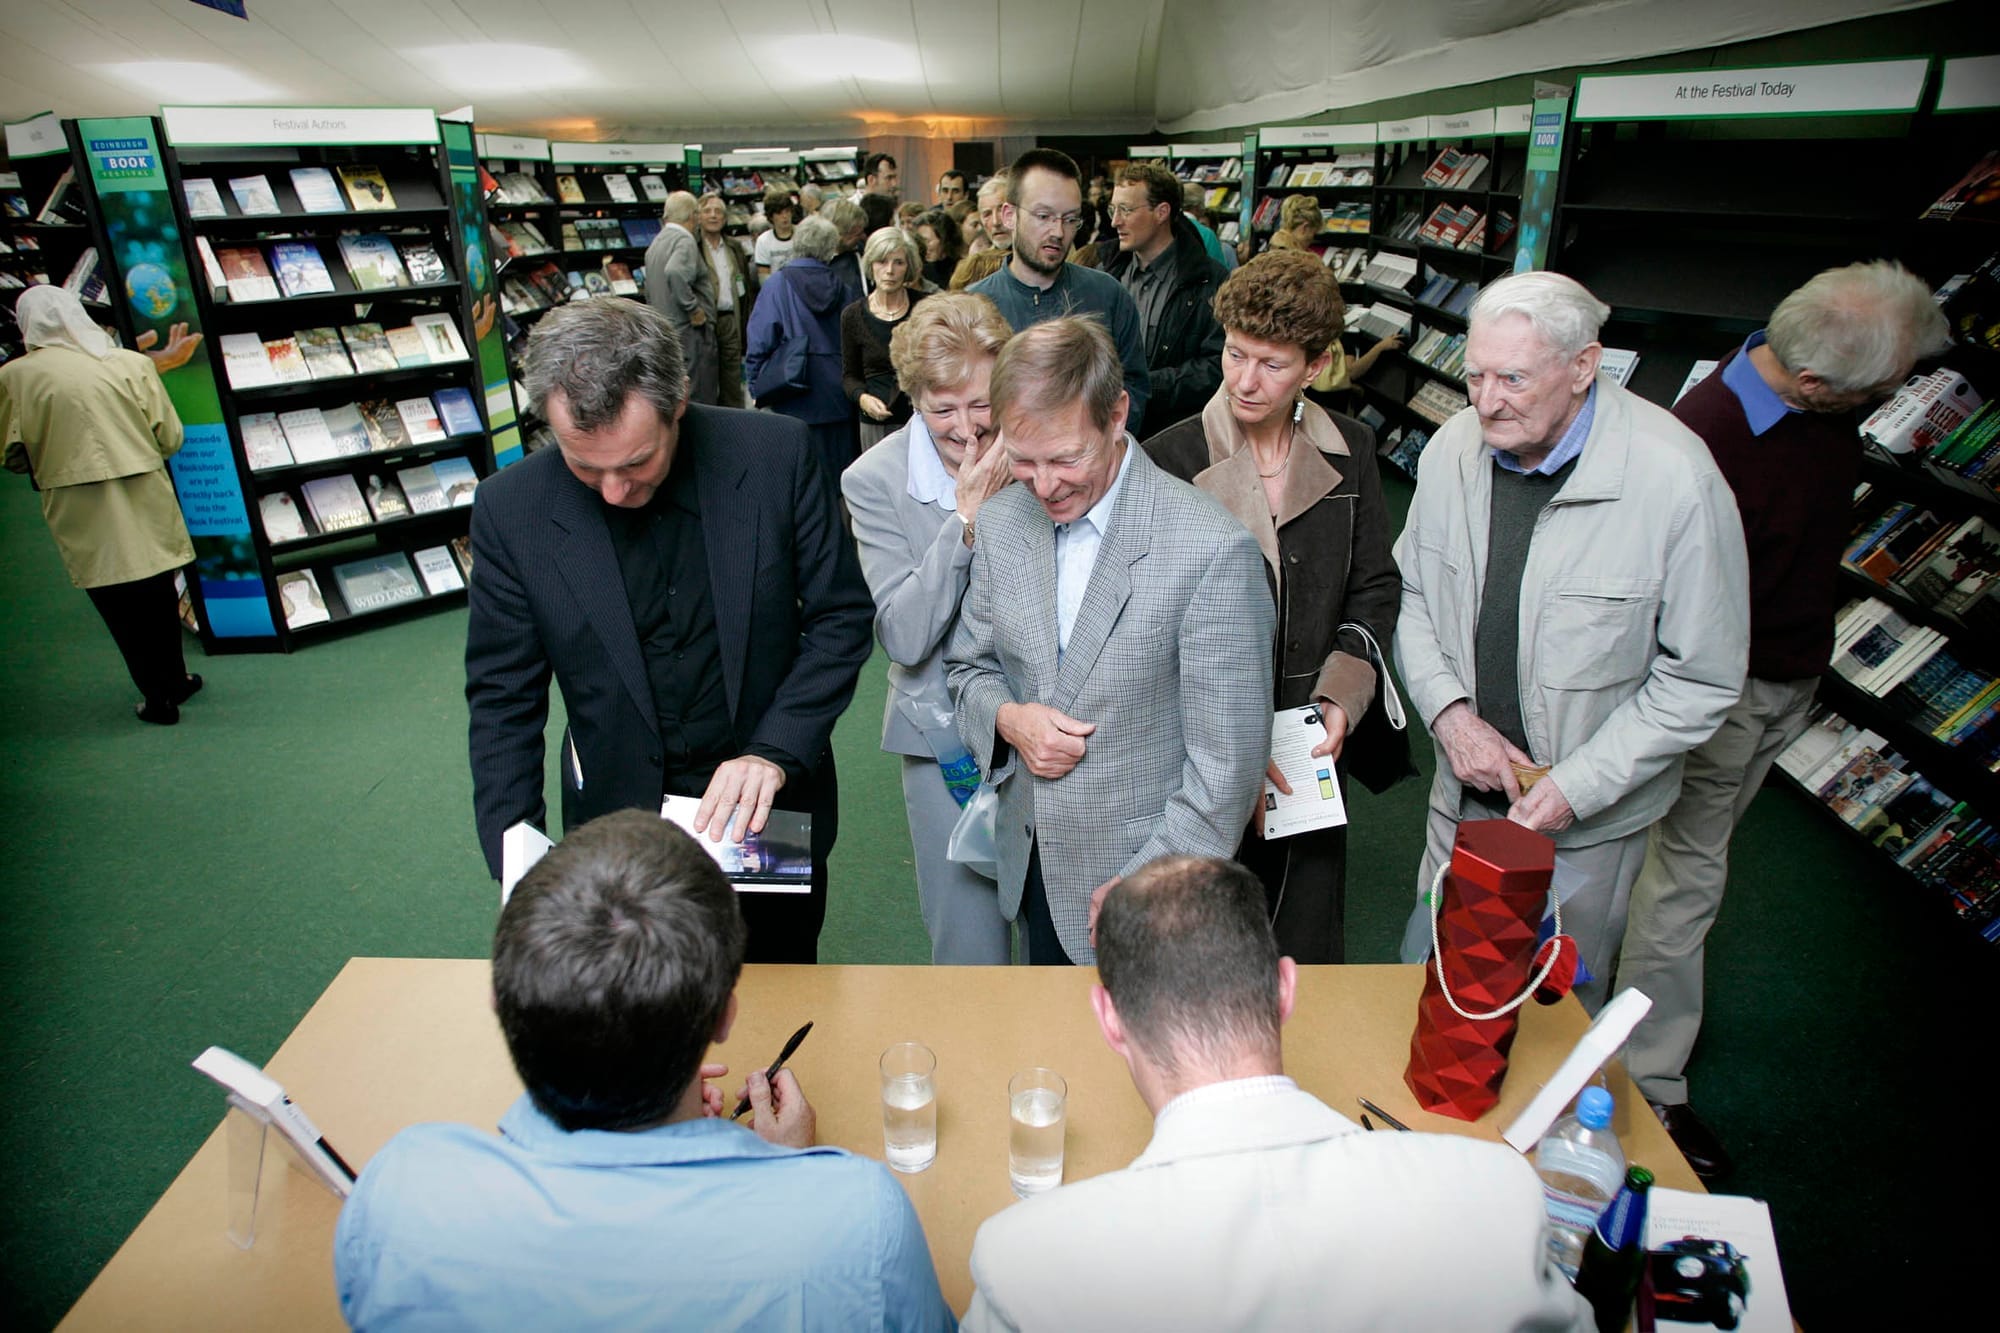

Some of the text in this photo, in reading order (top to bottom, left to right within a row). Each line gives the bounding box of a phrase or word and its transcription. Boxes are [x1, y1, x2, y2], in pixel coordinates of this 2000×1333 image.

[1675, 82, 1796, 99] At the Festival Today
[94, 141, 144, 150] EDINBURGH
[1536, 134, 1556, 145] BOOK
[108, 157, 148, 169] BOOK
[1919, 375, 1953, 406] BLEEDOUT
[1925, 400, 1964, 433] BLEEDO
[183, 434, 222, 444] roceeds
[178, 463, 225, 473] Bookshops
[328, 509, 362, 523] DAVID
[325, 515, 370, 532] STARKEY
[352, 584, 419, 610] WILD LAND
